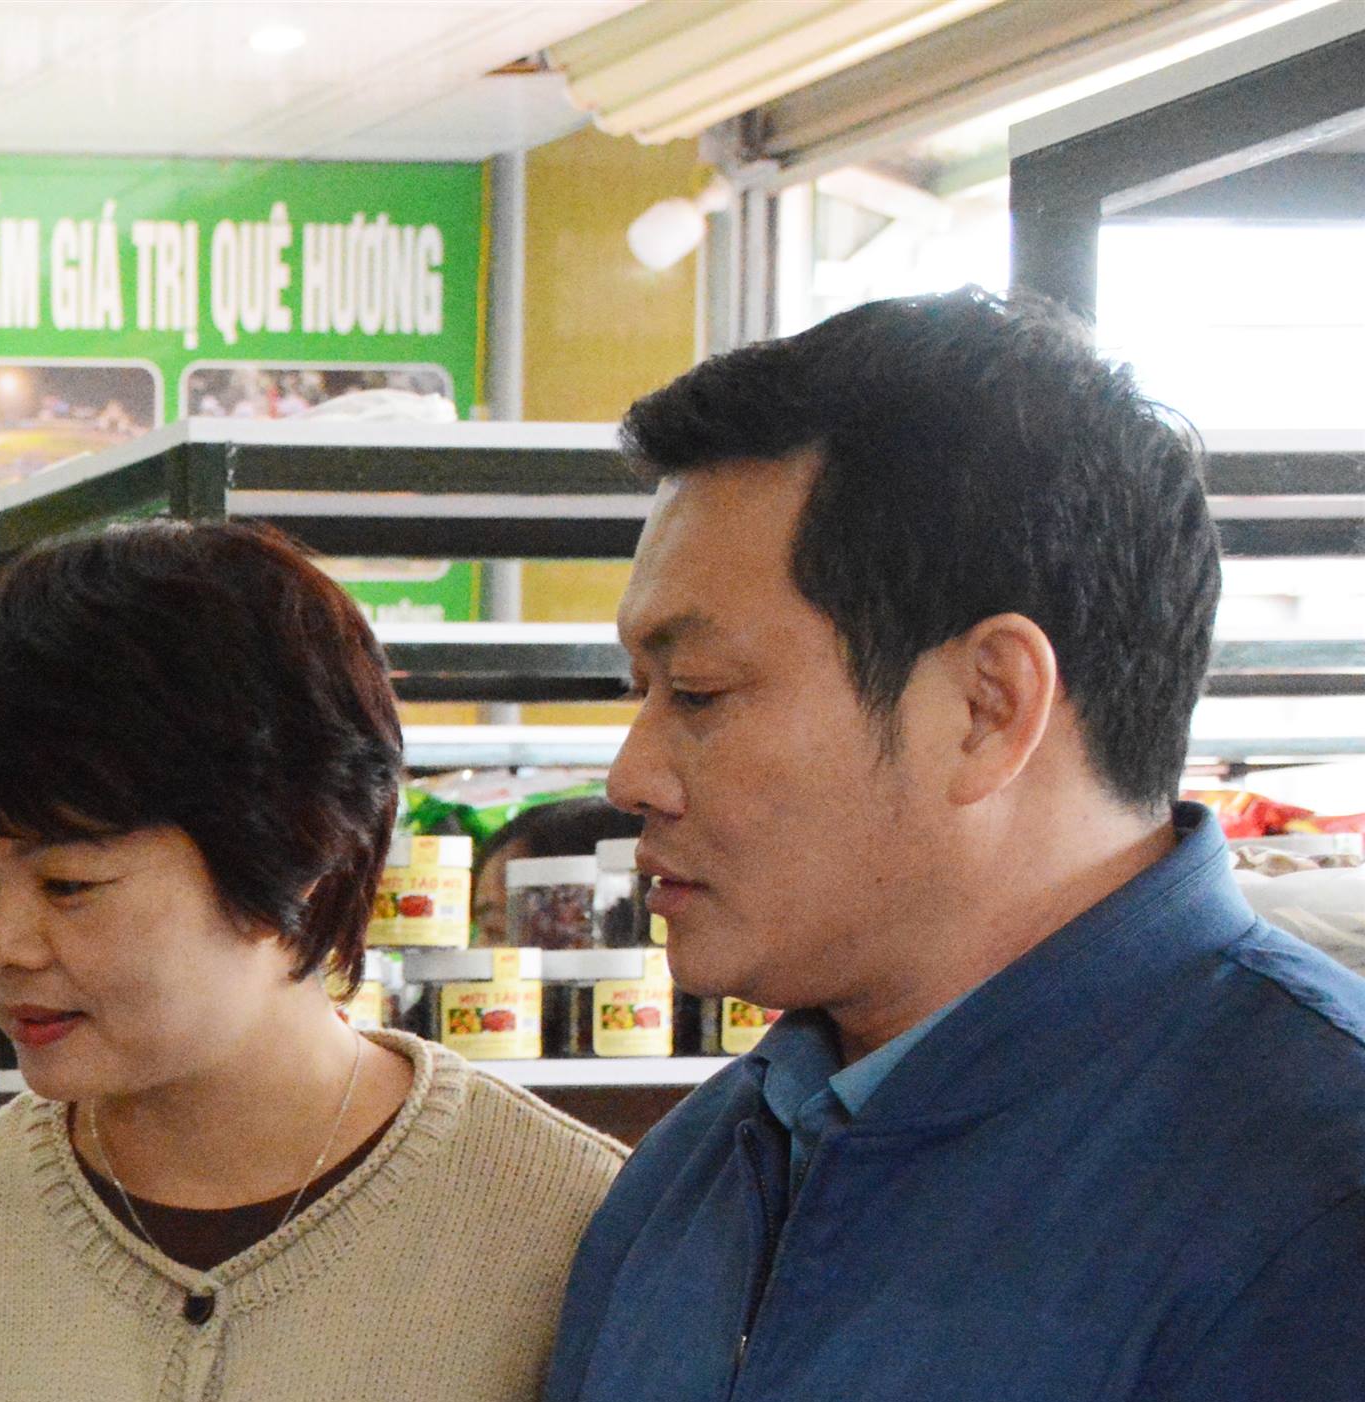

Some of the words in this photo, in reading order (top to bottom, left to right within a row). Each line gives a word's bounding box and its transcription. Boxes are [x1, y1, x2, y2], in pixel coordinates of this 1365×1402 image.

[51, 199, 123, 331] GIÁ
[132, 220, 198, 350] TRỊ
[211, 201, 291, 344] QUÊ
[302, 212, 444, 335] HƯƠNG
